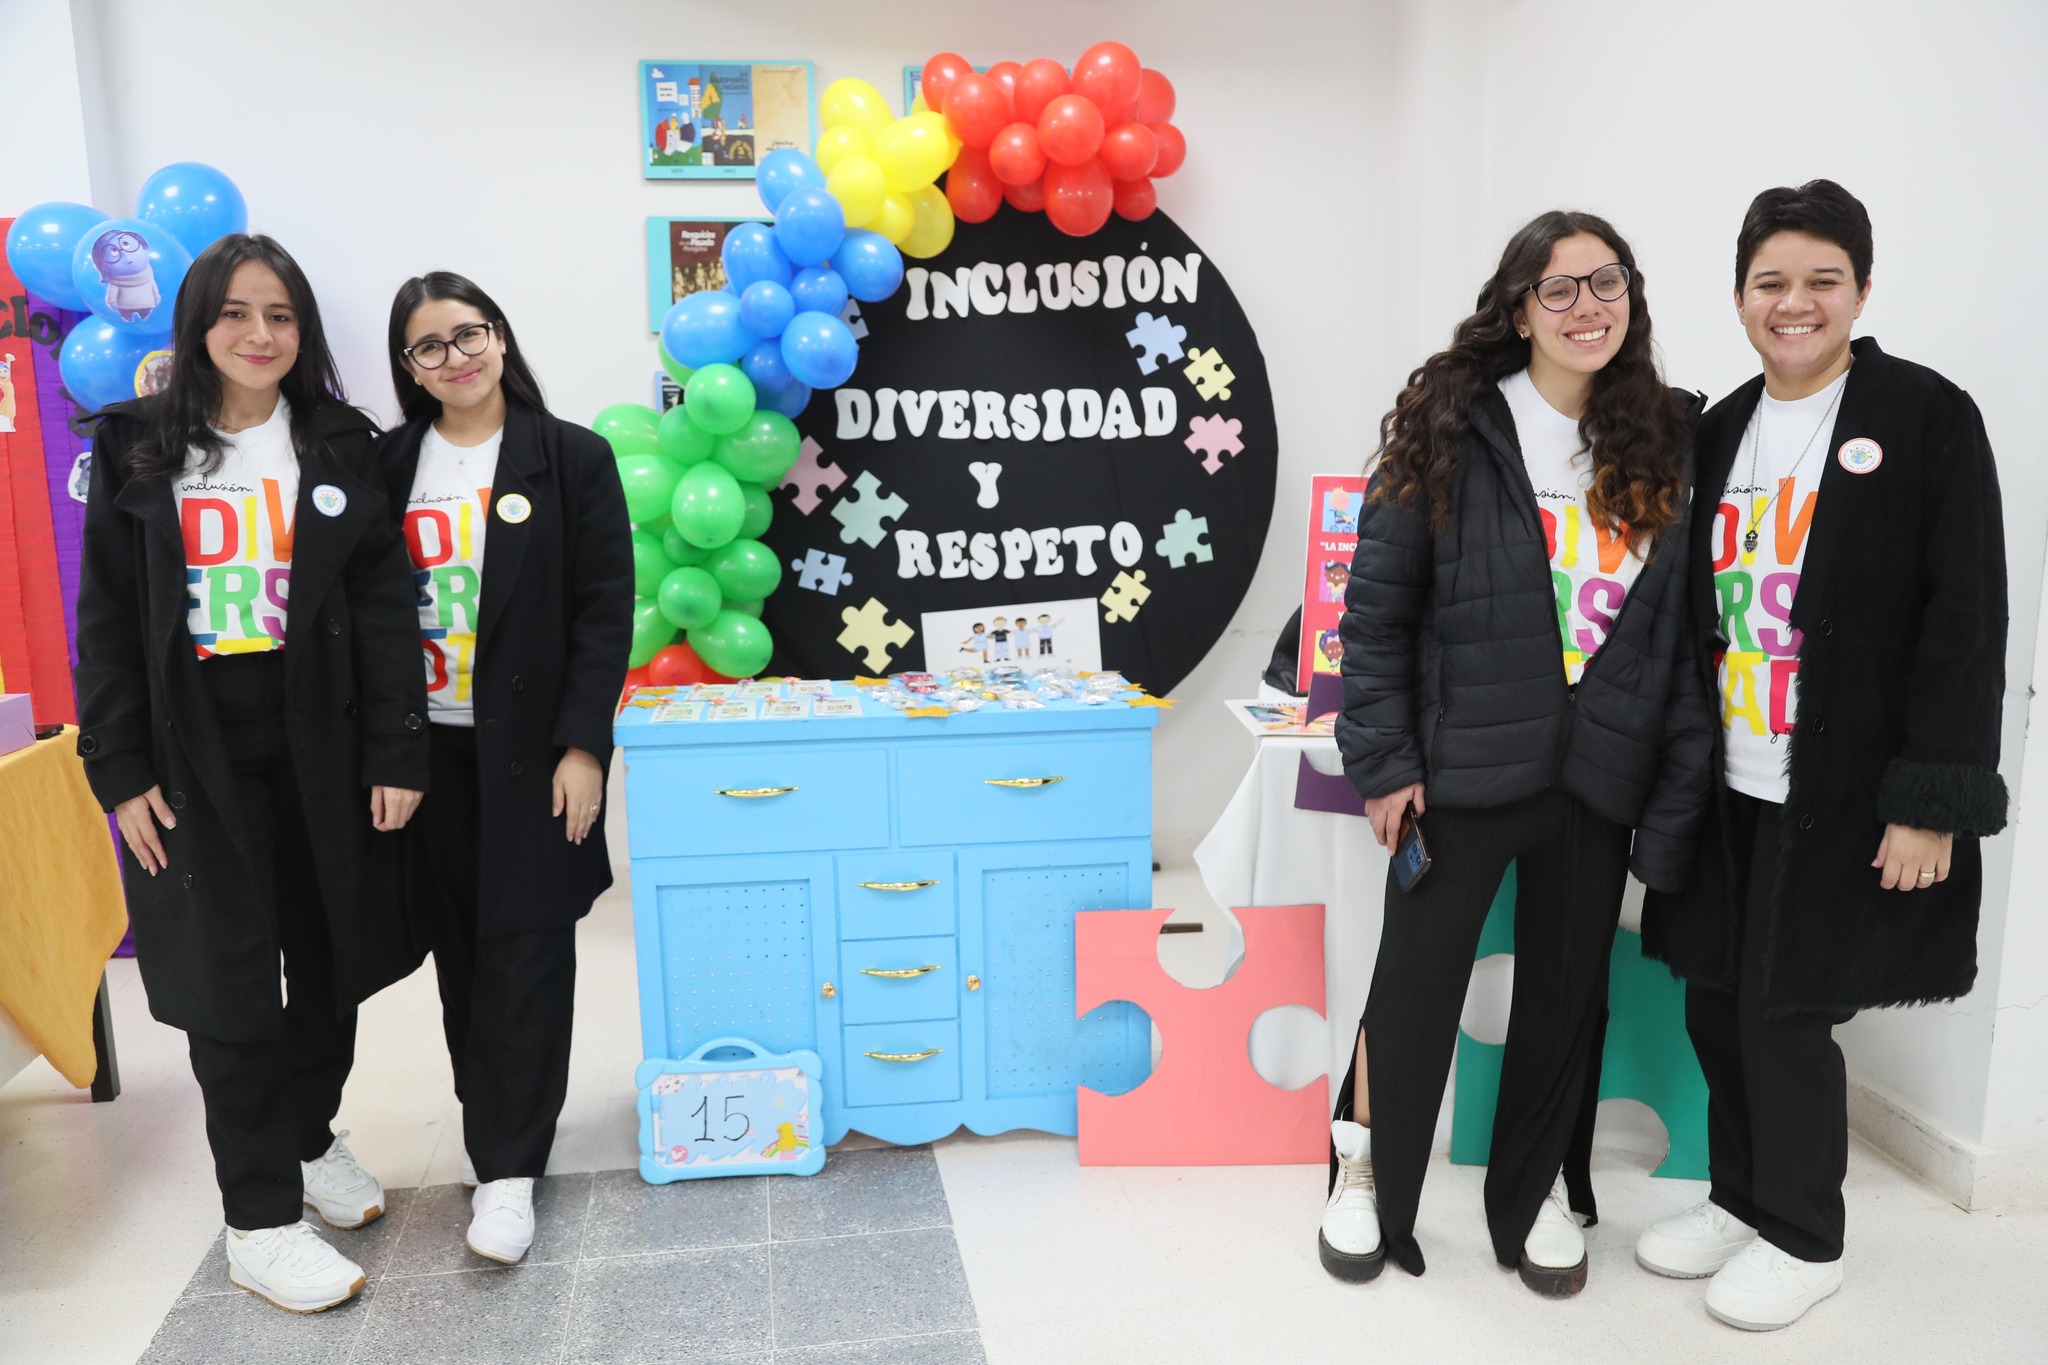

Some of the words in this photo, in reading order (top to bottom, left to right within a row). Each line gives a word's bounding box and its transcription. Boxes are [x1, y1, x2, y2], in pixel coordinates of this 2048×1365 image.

[905, 242, 1202, 321] INCLUSIÓN
[834, 386, 1178, 442] DIVERSIDAD
[968, 461, 1003, 509] Y
[894, 521, 1144, 581] RESPETO
[690, 1095, 750, 1142] 15
